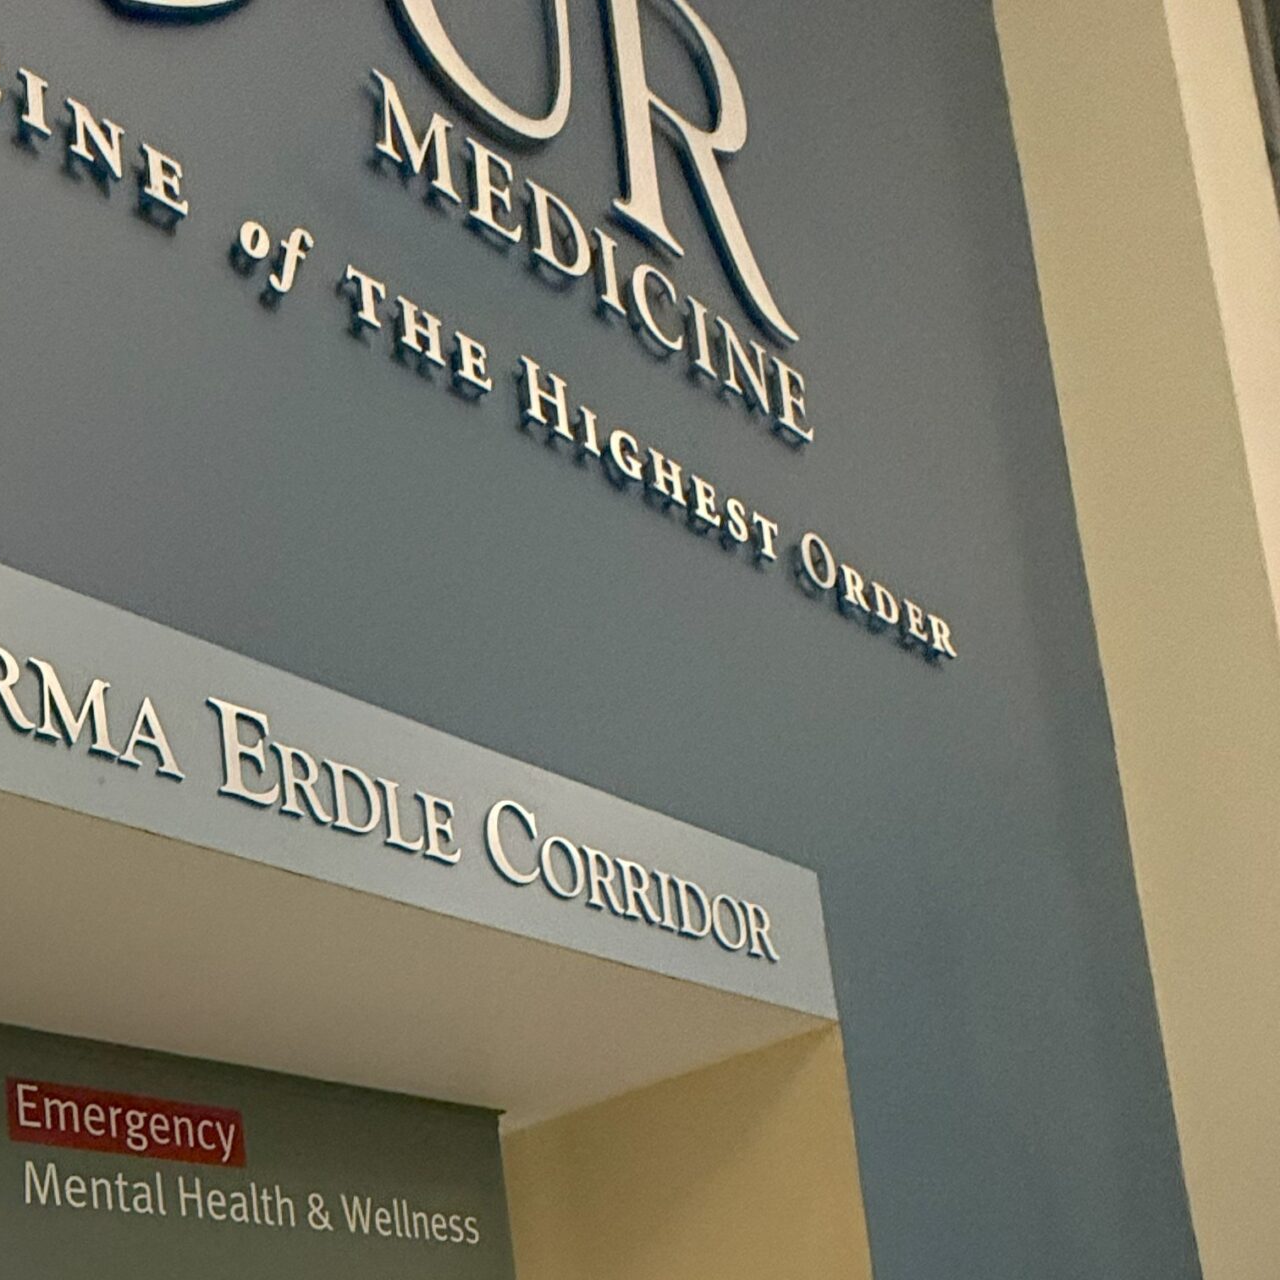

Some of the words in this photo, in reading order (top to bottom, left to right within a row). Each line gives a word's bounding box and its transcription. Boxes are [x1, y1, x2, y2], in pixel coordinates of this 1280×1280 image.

[372, 68, 813, 442] MEDICINE
[239, 220, 313, 293] of
[346, 265, 492, 391] THE
[521, 356, 777, 560] HIGHEST
[801, 532, 957, 658] ORDER
[207, 697, 461, 864] ERDLE
[485, 800, 780, 961] CORRIDOR
[16, 1083, 236, 1163] Emergency
[24, 1161, 166, 1216] Mental
[177, 1177, 296, 1227] Health
[307, 1193, 333, 1231] &
[340, 1195, 480, 1244] Wellness
